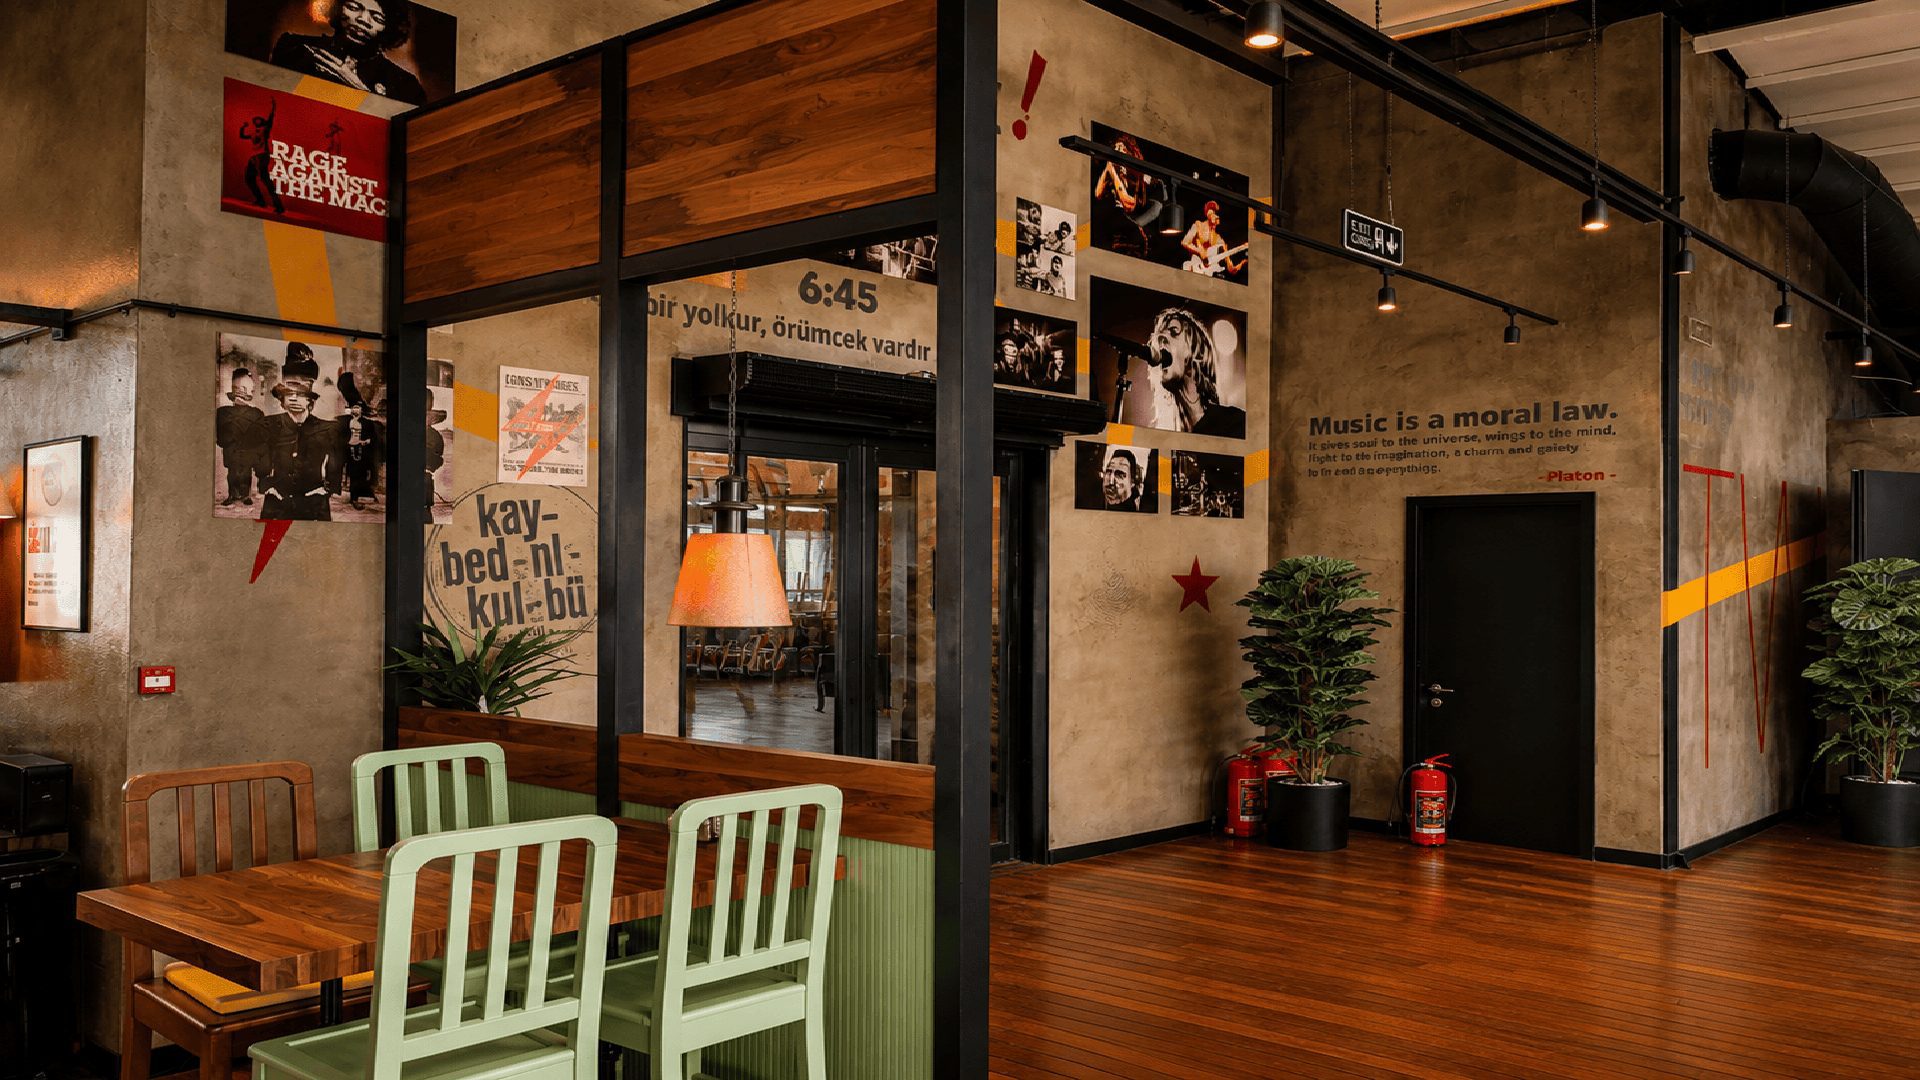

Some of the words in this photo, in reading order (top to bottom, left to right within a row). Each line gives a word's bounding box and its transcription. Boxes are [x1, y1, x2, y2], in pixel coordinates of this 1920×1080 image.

[270, 139, 347, 174] RAGE
[269, 158, 378, 197] AGAINST
[270, 177, 325, 203] THE
[328, 188, 390, 217] MAC
[799, 271, 879, 314] 6:45
[682, 303, 767, 338] yolkur,
[772, 315, 868, 351] örümcek
[872, 337, 932, 361] vardır
[1309, 413, 1388, 436] Music
[1396, 411, 1419, 431] is
[1428, 413, 1445, 429] a
[1453, 402, 1542, 428] moral
[1553, 401, 1618, 422] law.
[1341, 453, 1352, 462] to
[1508, 445, 1533, 455] and
[1382, 438, 1395, 448] to
[1398, 436, 1418, 446] the
[1485, 430, 1526, 443] wings
[1529, 430, 1544, 440] to
[1549, 427, 1572, 438] the
[1546, 470, 1605, 482] Platon
[476, 494, 559, 542] kay-
